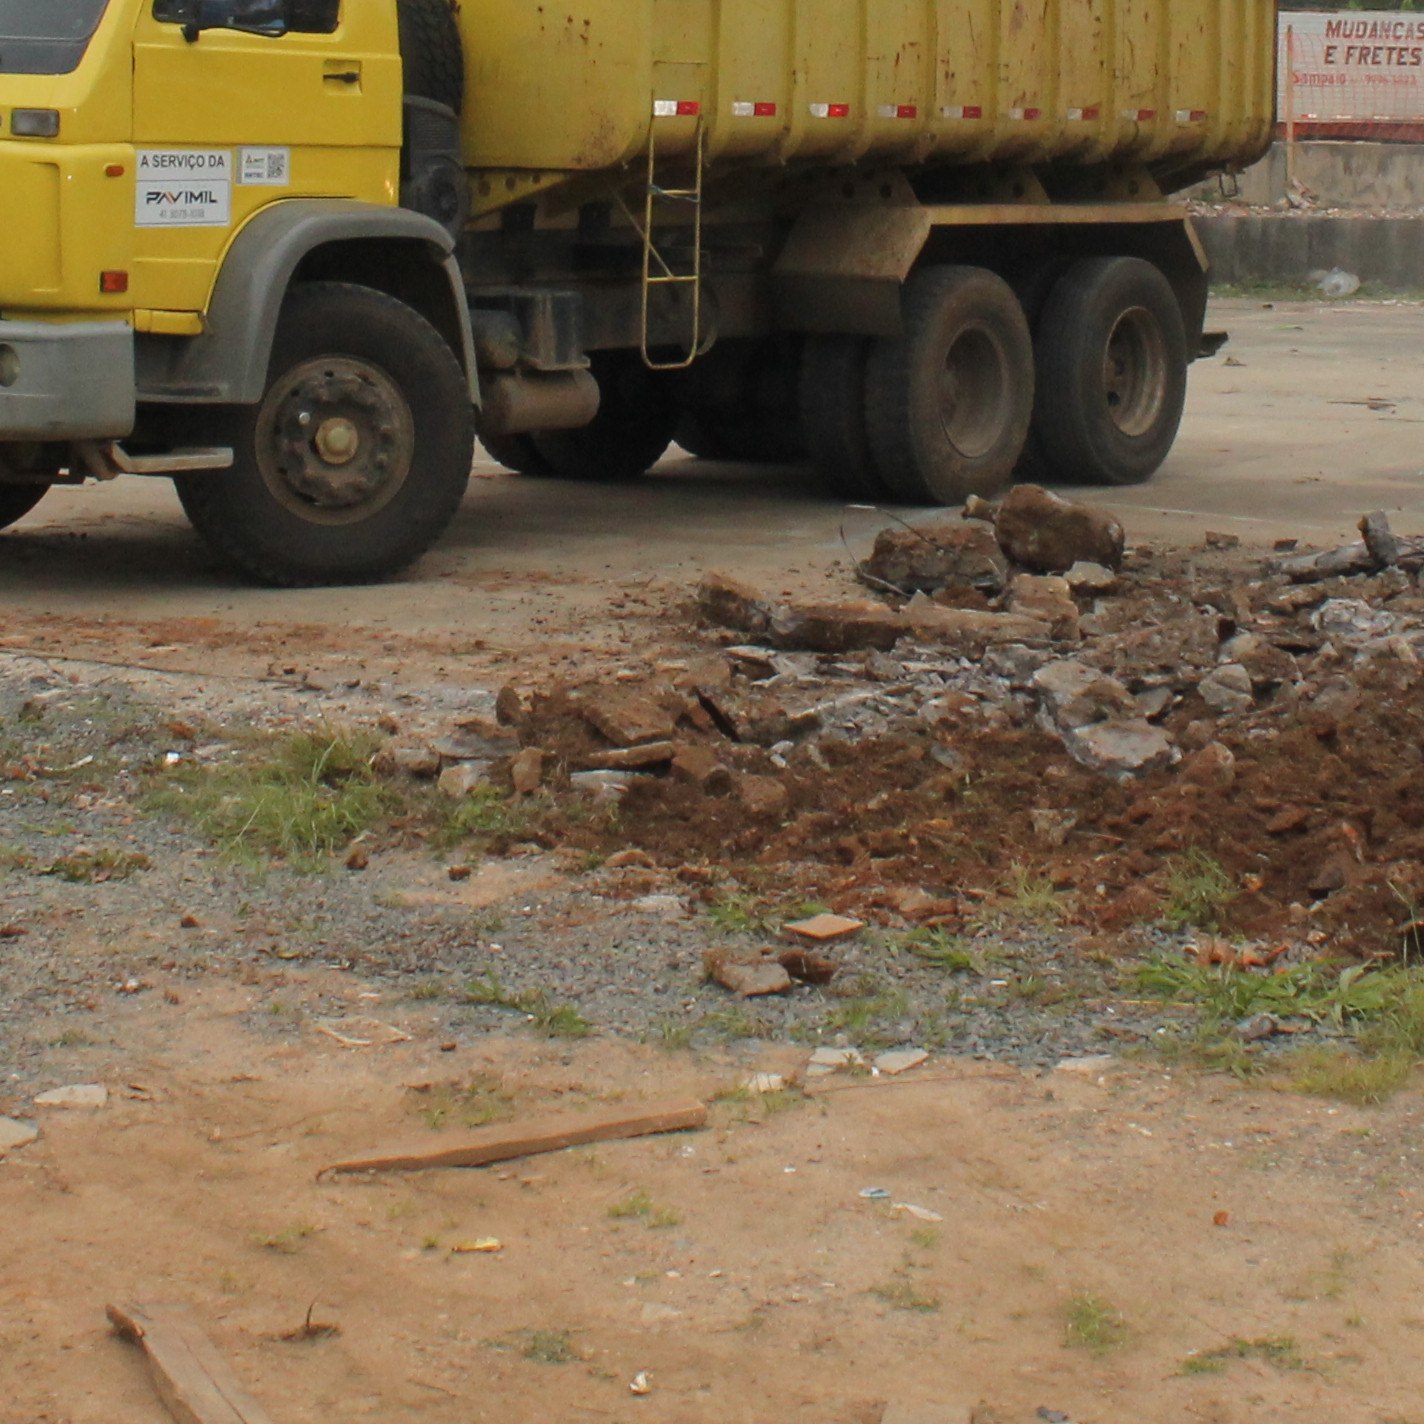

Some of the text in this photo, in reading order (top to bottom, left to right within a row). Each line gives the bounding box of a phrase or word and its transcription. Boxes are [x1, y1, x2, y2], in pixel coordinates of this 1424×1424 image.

[1324, 45, 1423, 65] E FRETES
[140, 154, 225, 170] A SERVIÇO DA
[146, 191, 218, 205] PAVIMIL
